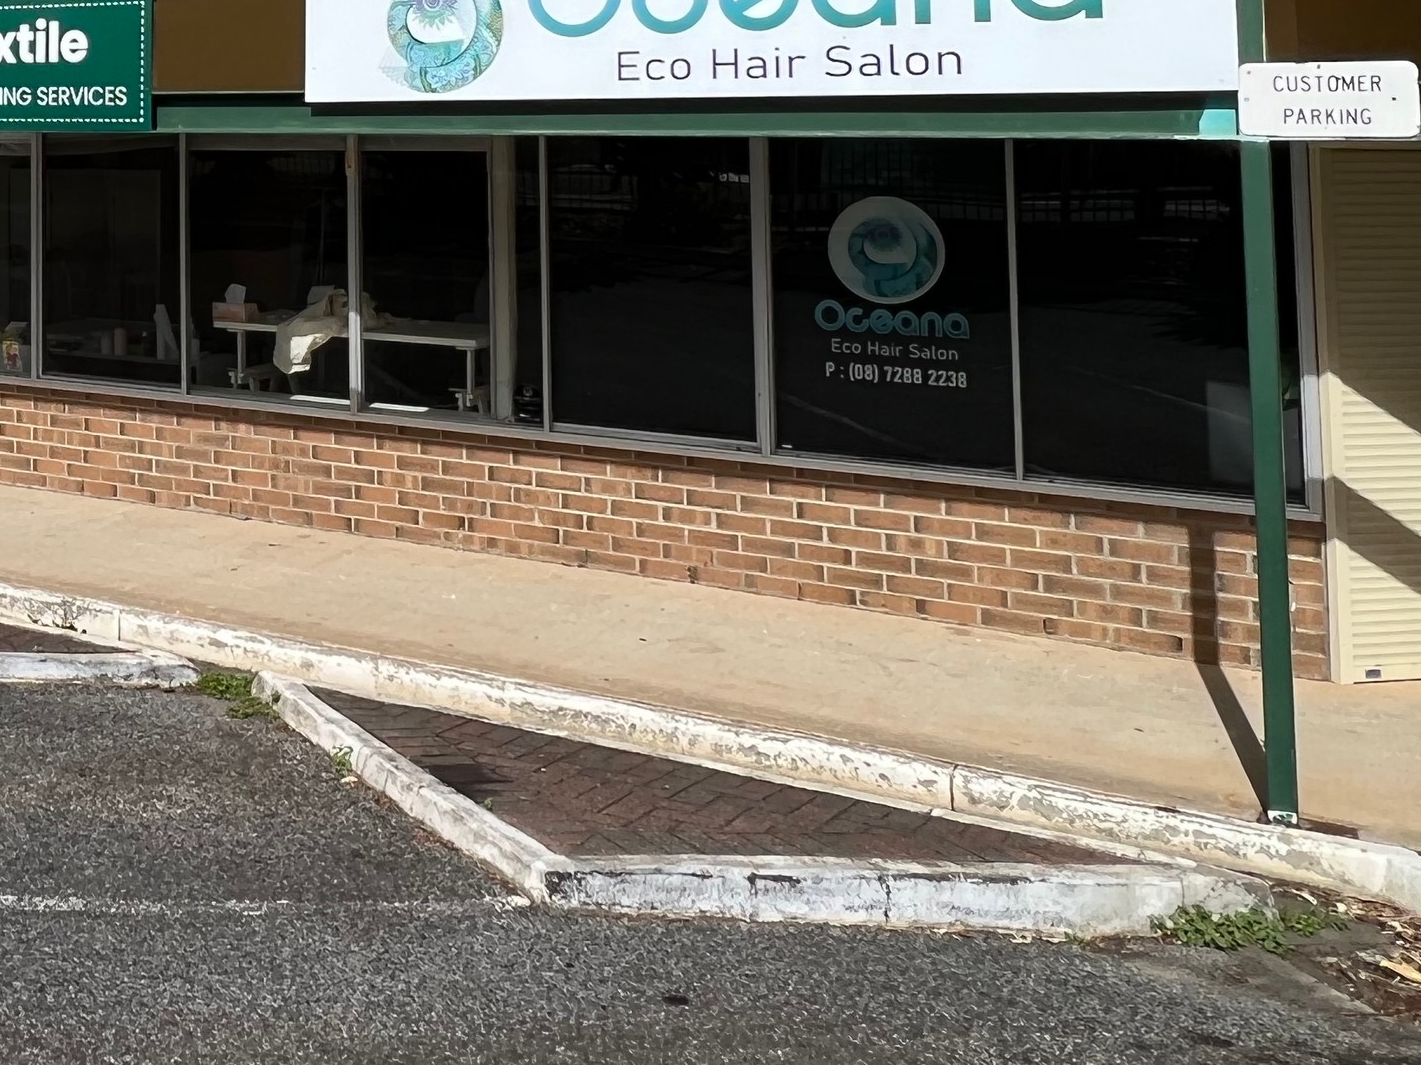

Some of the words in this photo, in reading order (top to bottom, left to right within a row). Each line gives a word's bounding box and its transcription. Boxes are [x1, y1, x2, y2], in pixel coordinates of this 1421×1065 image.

[616, 49, 693, 82] Eco
[711, 46, 807, 80] Hair
[824, 43, 964, 78] Salon
[1272, 74, 1383, 93] CUSTOMER
[36, 85, 128, 107] SERVICES
[1283, 107, 1373, 125] PARKING
[814, 298, 971, 340] Oceana
[830, 338, 862, 354] Eco
[867, 340, 904, 357] Hair
[908, 343, 959, 361] Salon
[848, 362, 879, 384] (08)
[883, 365, 923, 384] 7288
[927, 369, 968, 388] 2238
